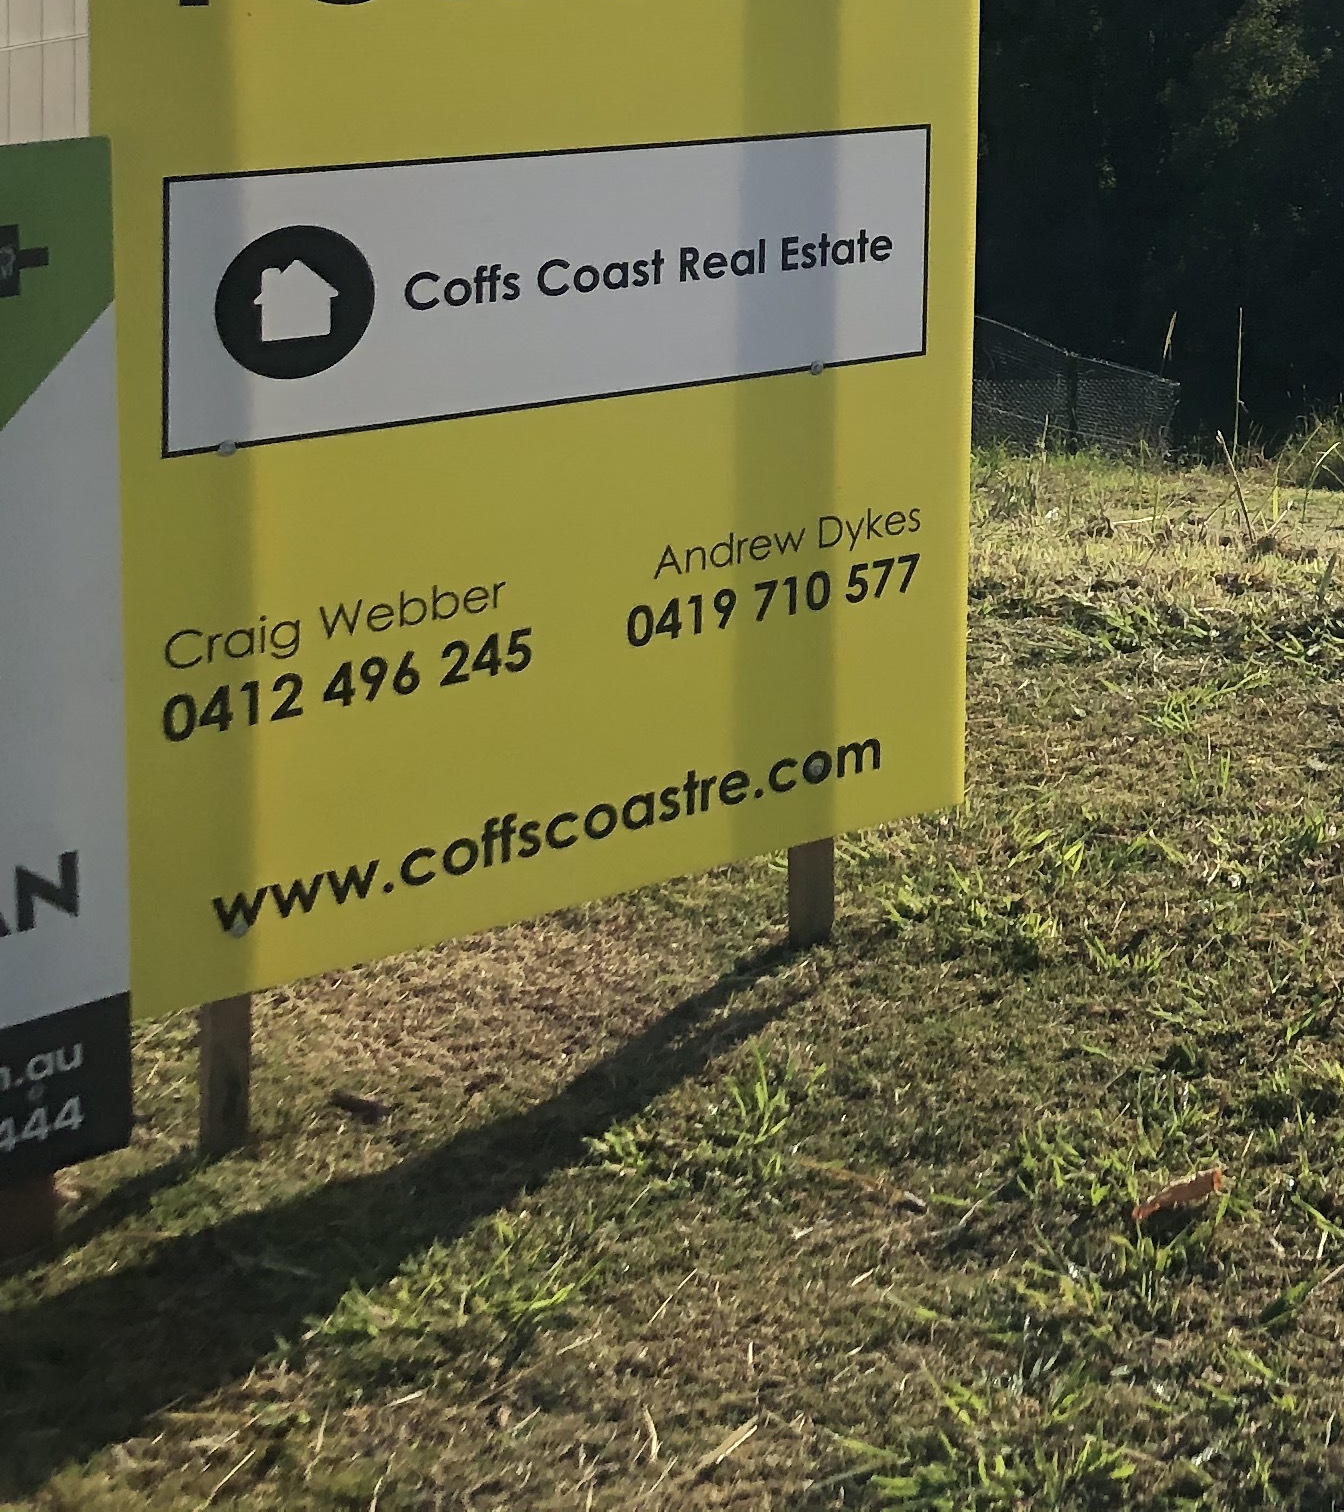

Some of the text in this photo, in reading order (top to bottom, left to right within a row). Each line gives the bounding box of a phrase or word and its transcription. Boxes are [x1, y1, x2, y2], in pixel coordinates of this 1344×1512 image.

[404, 229, 893, 310] Coffs Coast Real Estate
[654, 508, 921, 579] Andrew Dykes
[165, 581, 506, 669] Craig Webber
[627, 553, 920, 647] 0419 710 577
[162, 627, 532, 742] 0412 496 245
[212, 738, 881, 933] www.coffscoastre.com
[0, 850, 79, 937] N
